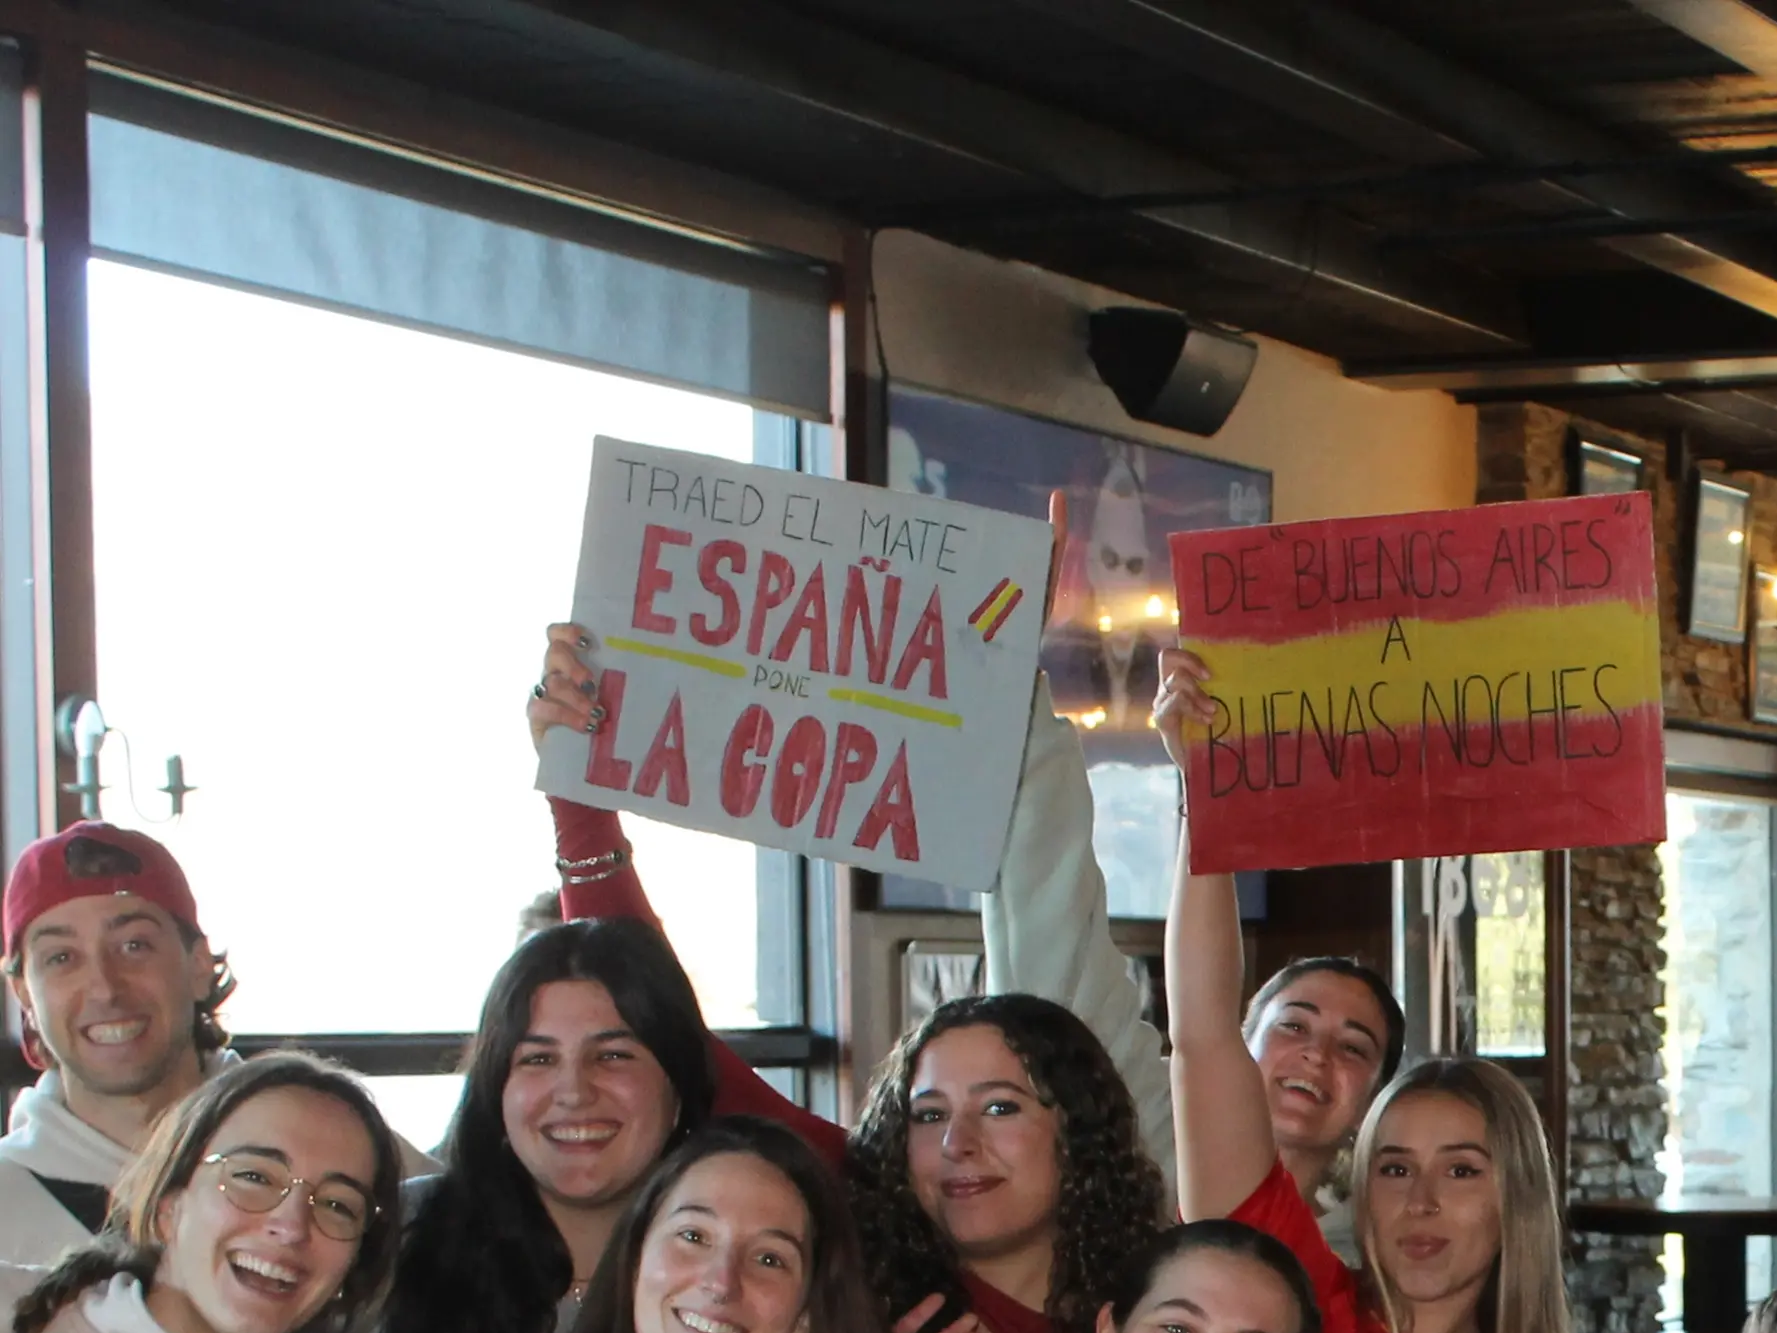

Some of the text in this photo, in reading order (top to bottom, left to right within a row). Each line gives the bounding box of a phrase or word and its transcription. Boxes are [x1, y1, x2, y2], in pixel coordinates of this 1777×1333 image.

[616, 458, 967, 574] TRAED EL MATE
[631, 523, 949, 700] ESPAÑA
[1201, 546, 1272, 616] DE
[1380, 613, 1412, 665] A
[752, 665, 811, 700] PONE
[1208, 663, 1624, 799] BUENAS NOCHES
[584, 668, 921, 863] LA COPA
